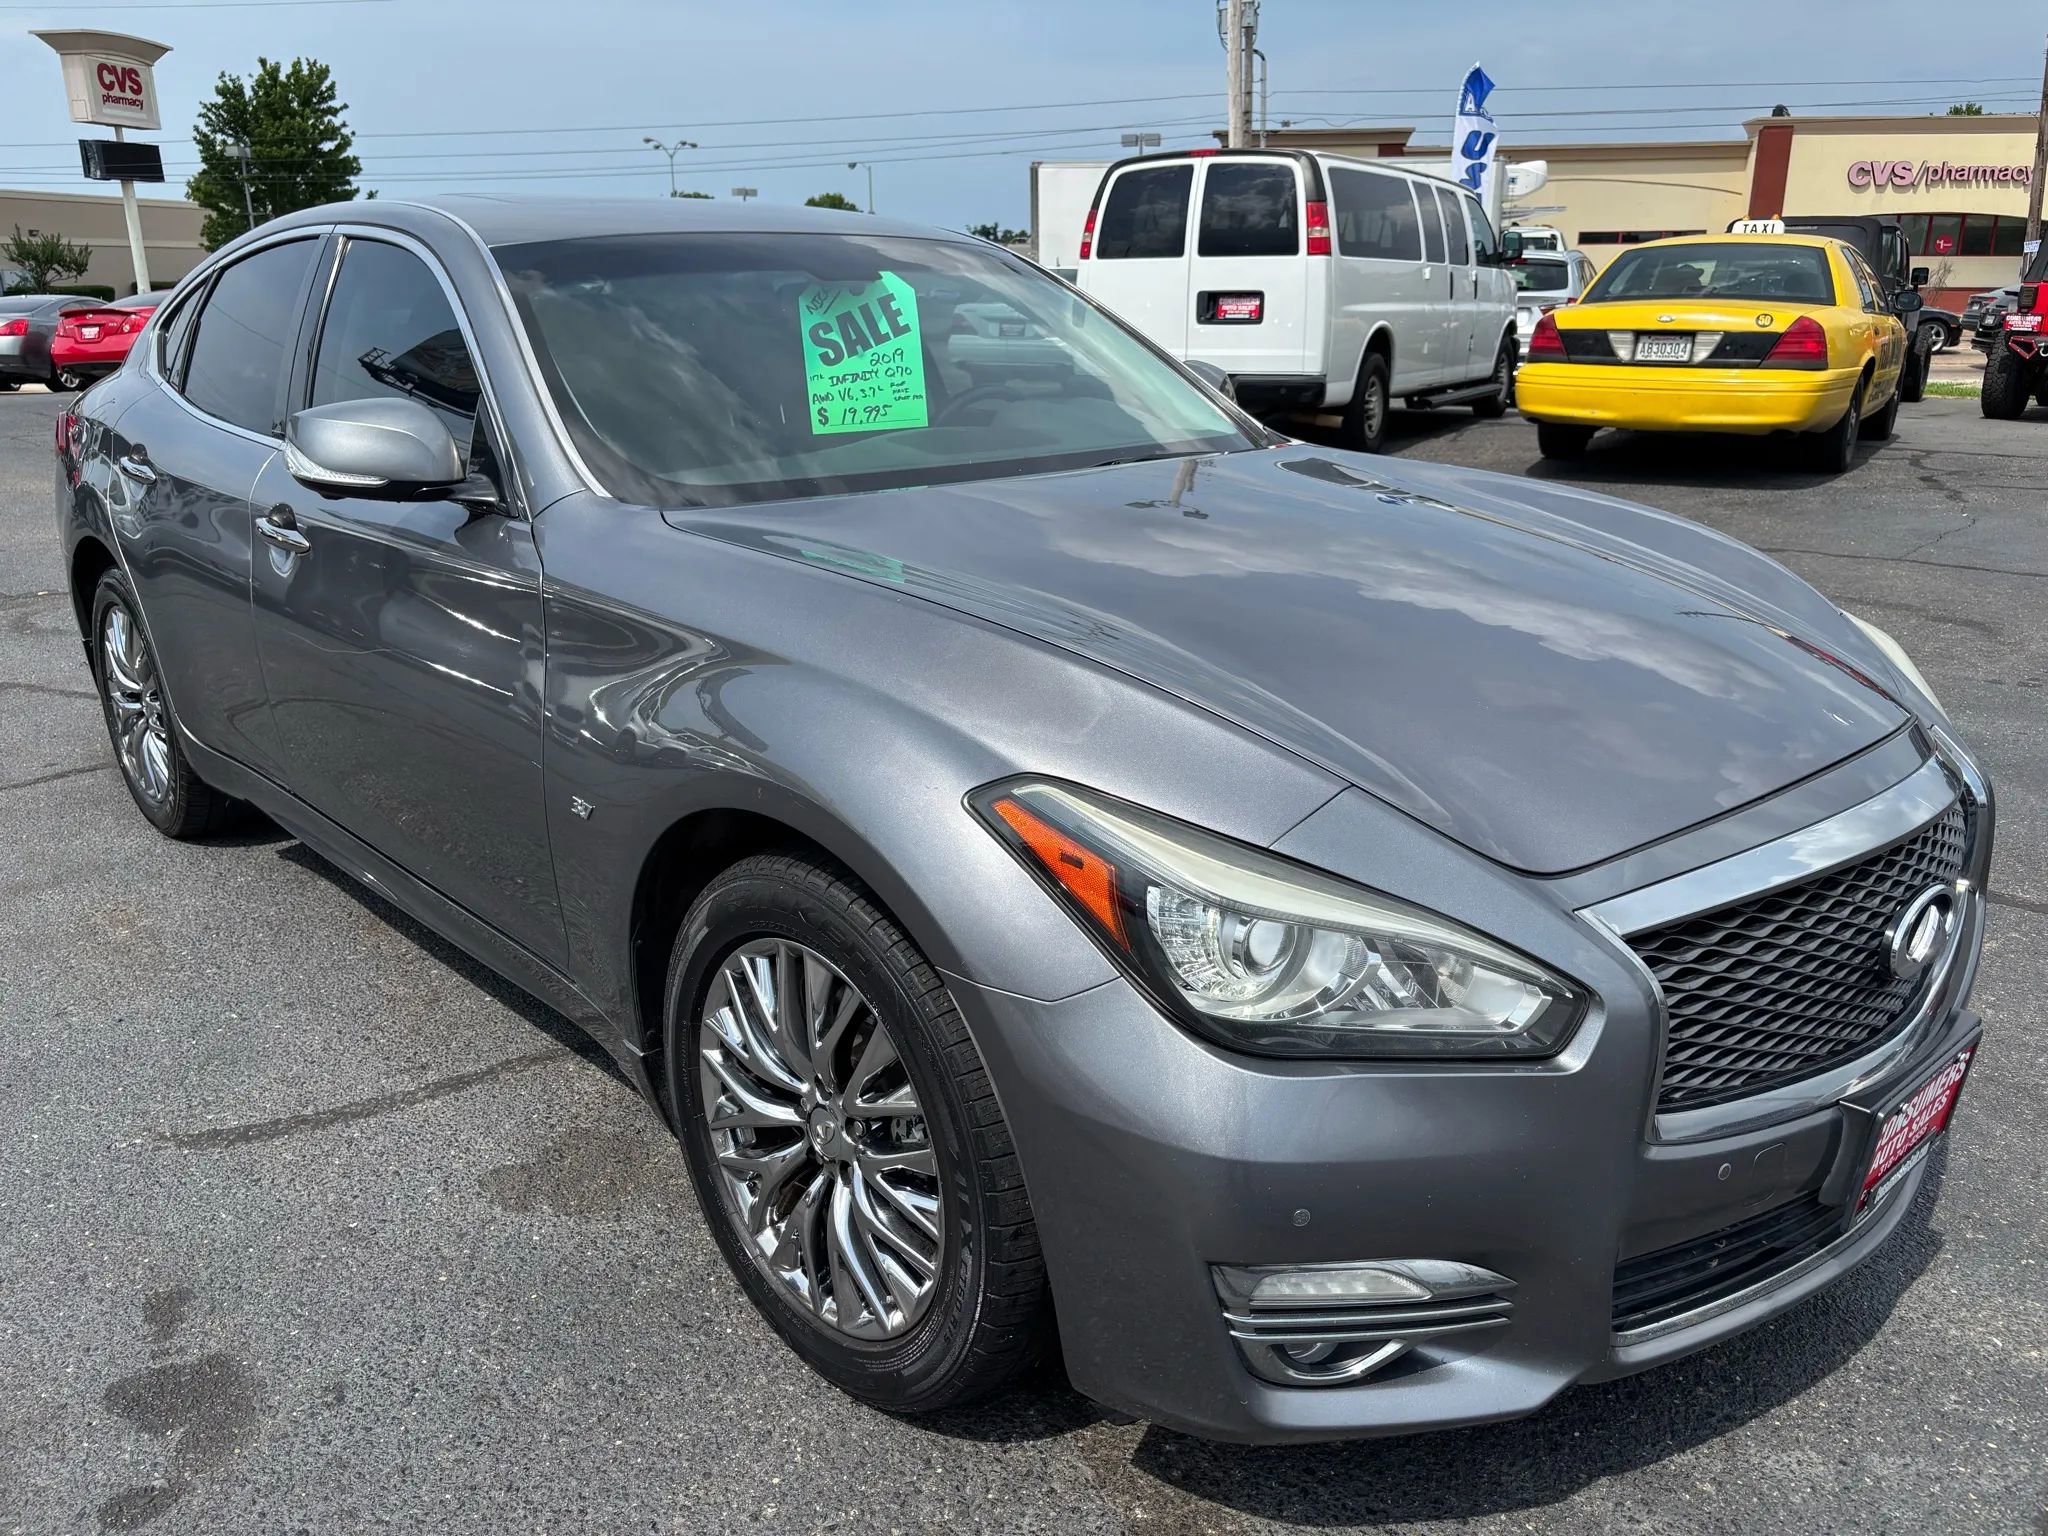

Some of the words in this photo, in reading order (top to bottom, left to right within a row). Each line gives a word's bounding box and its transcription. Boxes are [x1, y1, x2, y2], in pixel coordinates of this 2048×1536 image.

[96, 62, 143, 96] CVS
[101, 92, 144, 110] pharmacy
[1743, 223, 1775, 233] TAXI
[809, 293, 912, 366] SALE
[1758, 315, 1771, 327] 50
[869, 348, 904, 367] 2019
[828, 369, 880, 387] INFINITY
[885, 365, 913, 378] Q70
[812, 392, 835, 405] AWD
[816, 406, 829, 427] $
[1868, 1126, 1909, 1176] AUTO
[1908, 1090, 1950, 1138] SALES
